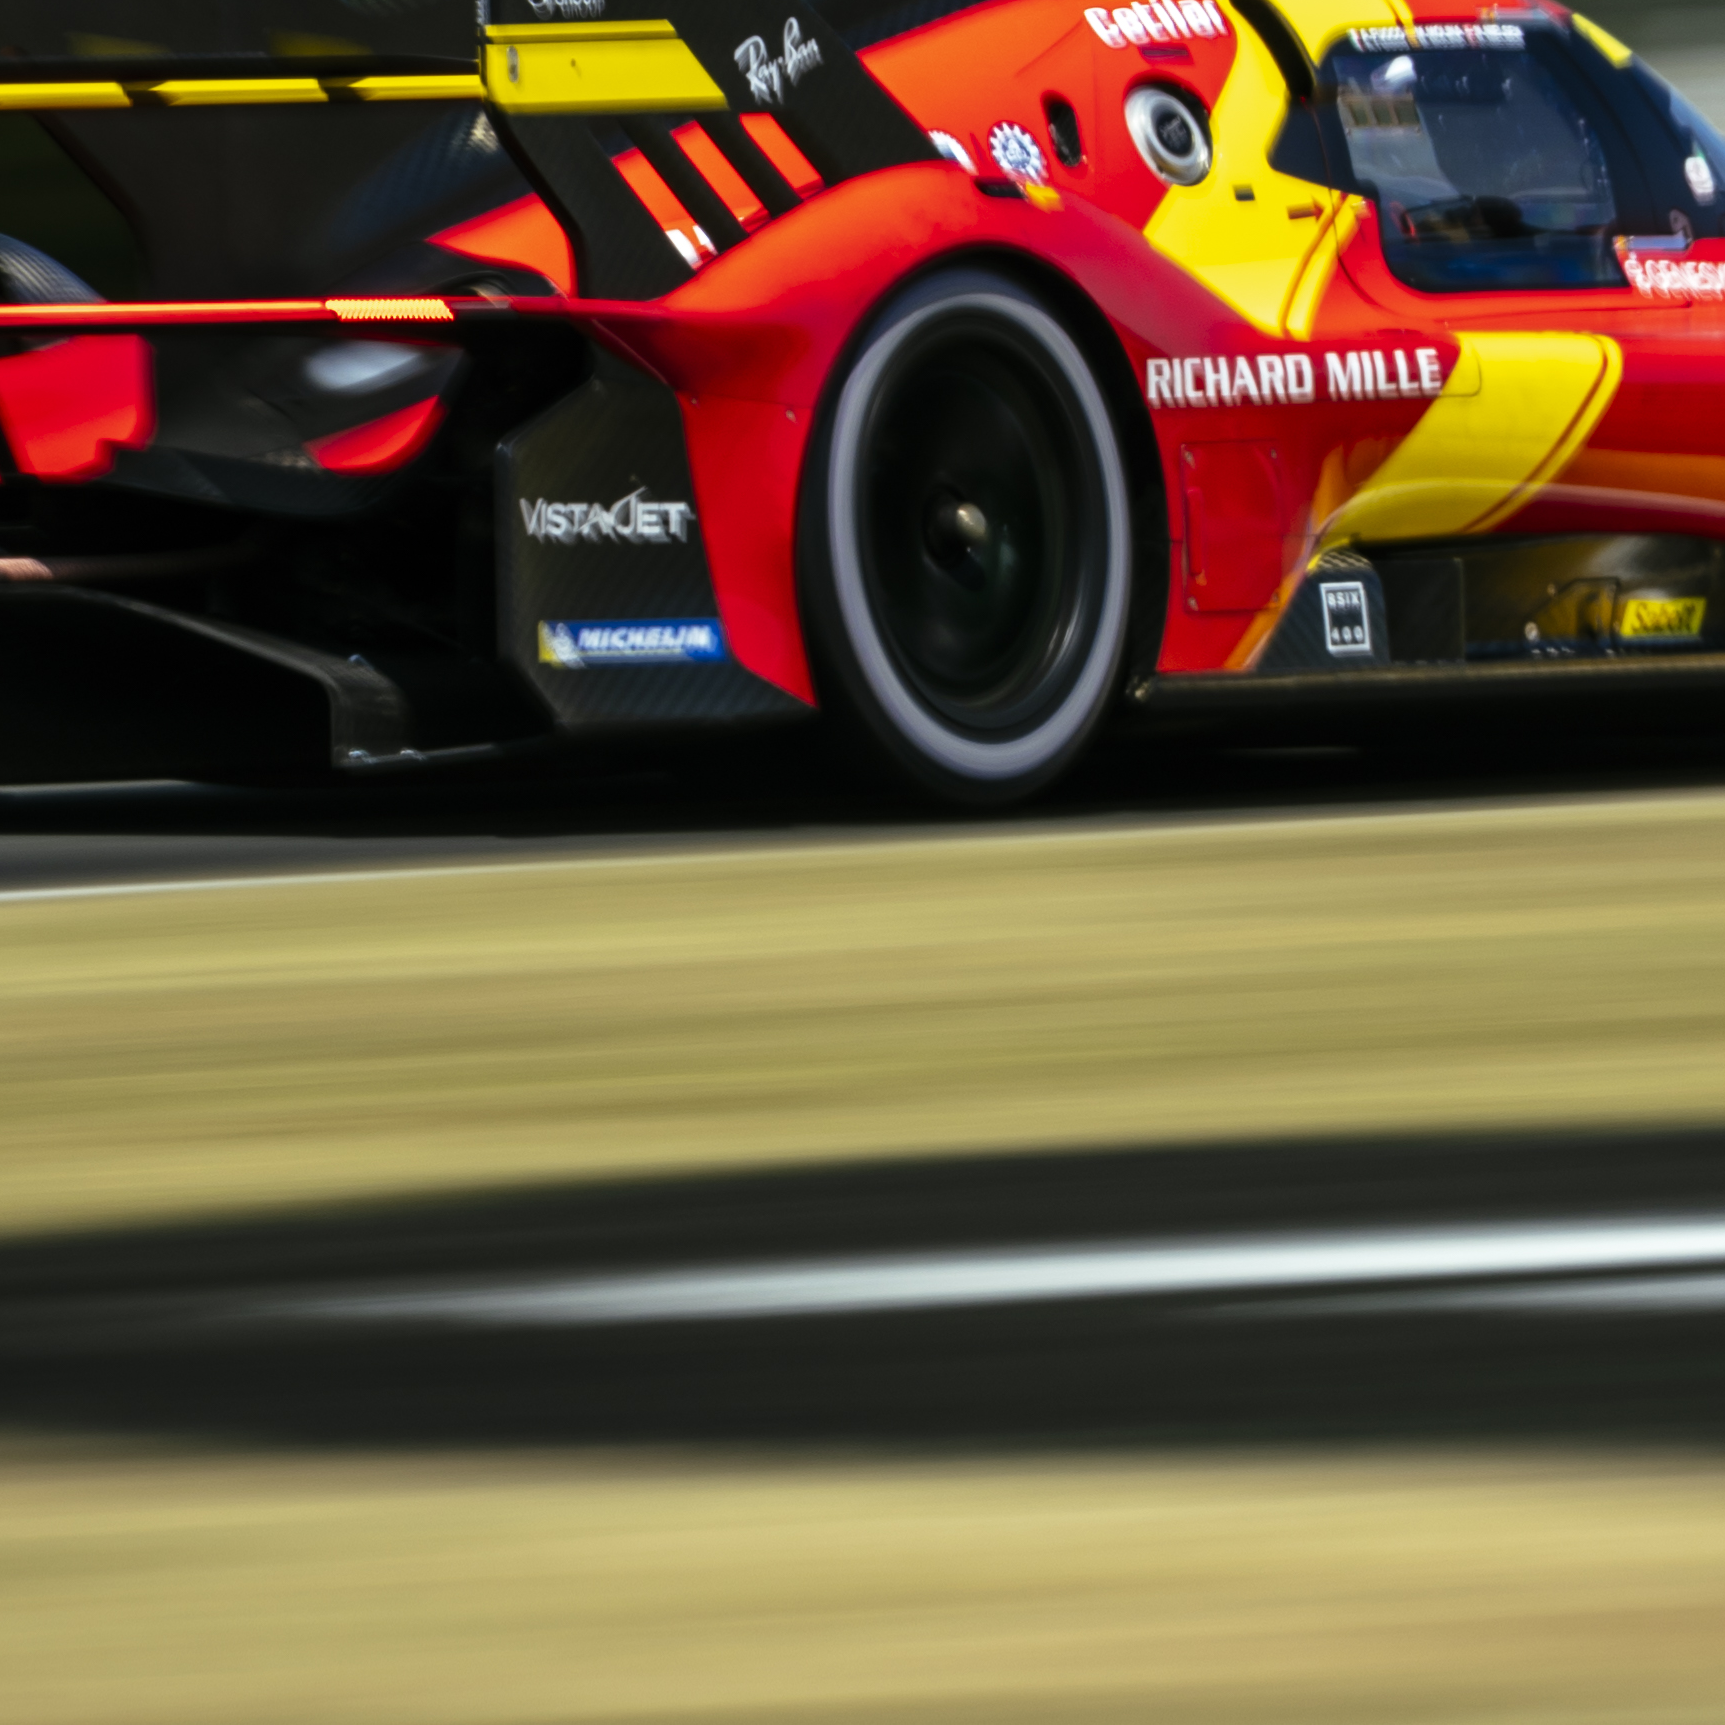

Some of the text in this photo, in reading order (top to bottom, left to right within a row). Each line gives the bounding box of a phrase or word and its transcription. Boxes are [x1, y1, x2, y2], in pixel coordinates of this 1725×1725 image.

[1146, 347, 1443, 407] RICHARD MILLE
[520, 486, 695, 543] VISTAJET
[577, 625, 716, 653] MICHELIN
